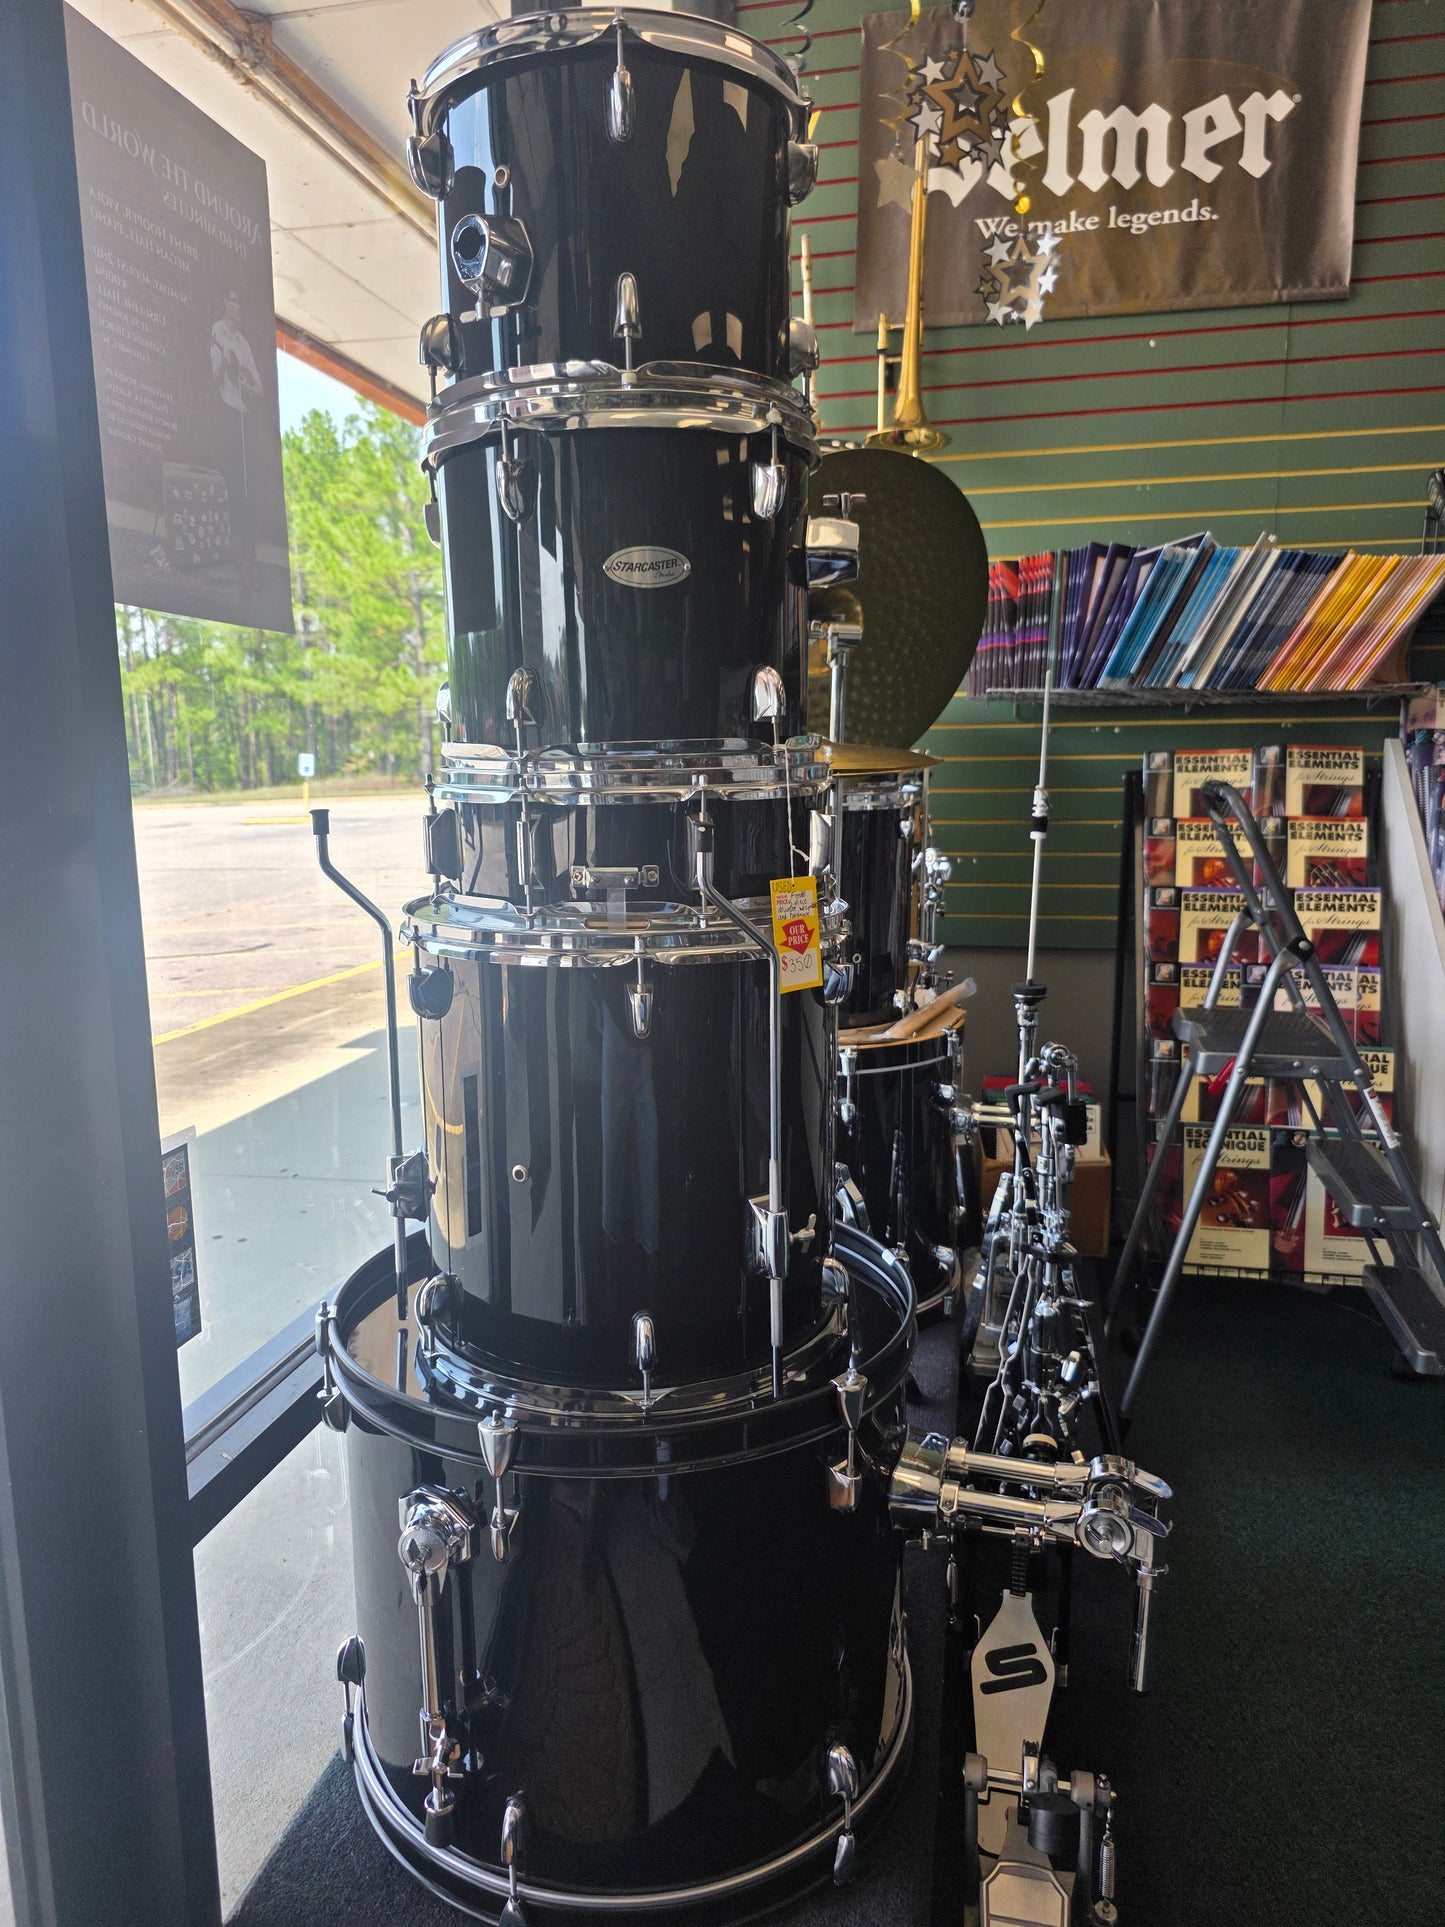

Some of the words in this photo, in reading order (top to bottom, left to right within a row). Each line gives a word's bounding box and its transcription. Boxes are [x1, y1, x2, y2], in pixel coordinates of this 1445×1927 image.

[974, 215, 1021, 240] We
[1027, 210, 1100, 236] make
[1107, 198, 1219, 234] legends.
[613, 558, 677, 572] STARCASTER
[1176, 755, 1248, 765] ESSENTIAL
[1288, 750, 1360, 760] ESSENTIAL
[1176, 764, 1247, 773] ELEMENTS
[1289, 760, 1359, 769] ELEMENTS
[1289, 822, 1363, 832] ESSENTIAL
[1290, 831, 1363, 841] ELEMENTS
[1183, 893, 1247, 903] ESSENTI
[1296, 893, 1377, 903] ESSENTIAL
[1183, 903, 1242, 912] ELEMEN
[1297, 903, 1376, 912] ELEMENTS
[789, 925, 806, 936] OUR
[788, 934, 809, 946] PRICE
[781, 953, 813, 973] $350
[1186, 1128, 1266, 1140] ESSNTIAL
[1187, 1140, 1265, 1151] TECNIQUE
